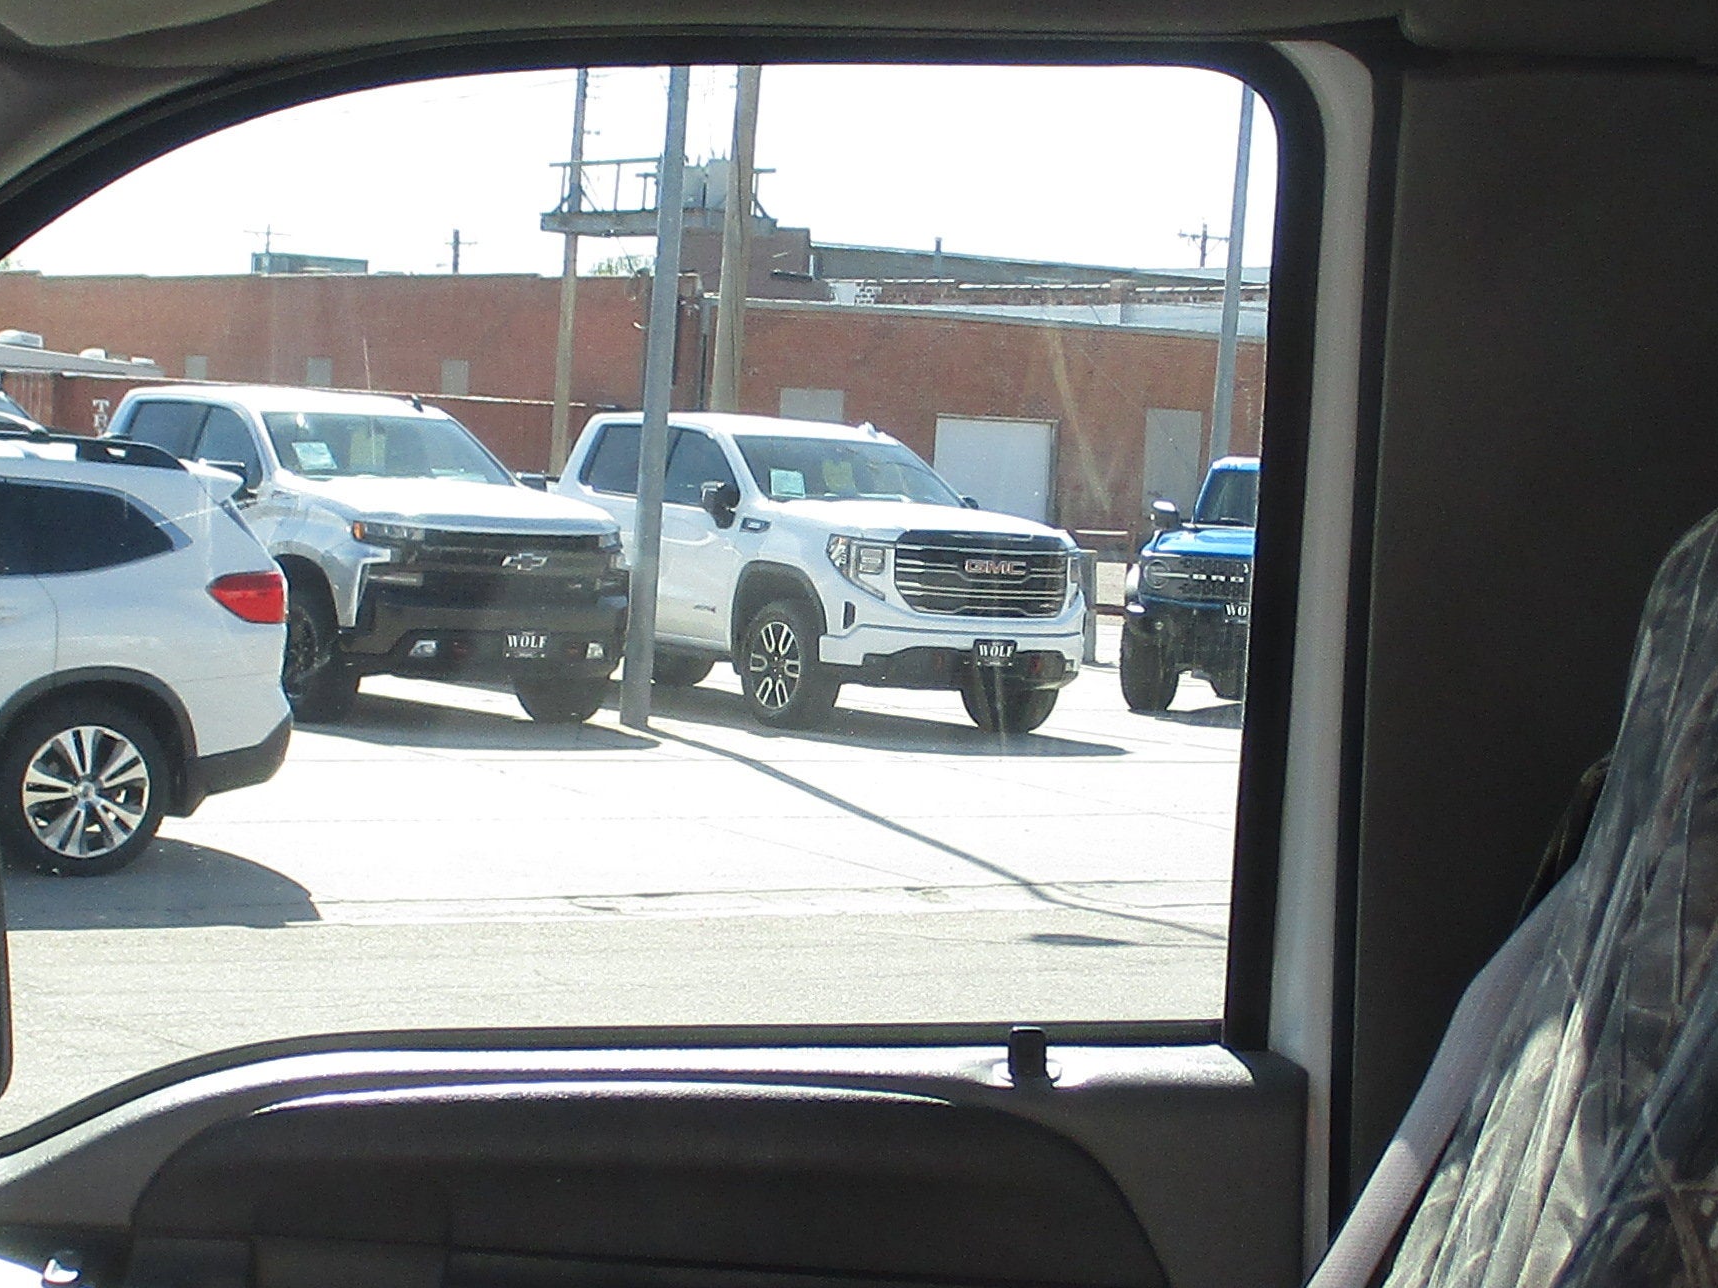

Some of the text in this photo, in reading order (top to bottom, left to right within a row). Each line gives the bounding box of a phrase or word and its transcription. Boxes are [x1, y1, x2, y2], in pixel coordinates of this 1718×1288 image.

[964, 559, 1027, 575] GMC
[507, 634, 548, 649] WOLF
[978, 643, 1015, 658] WOLF
